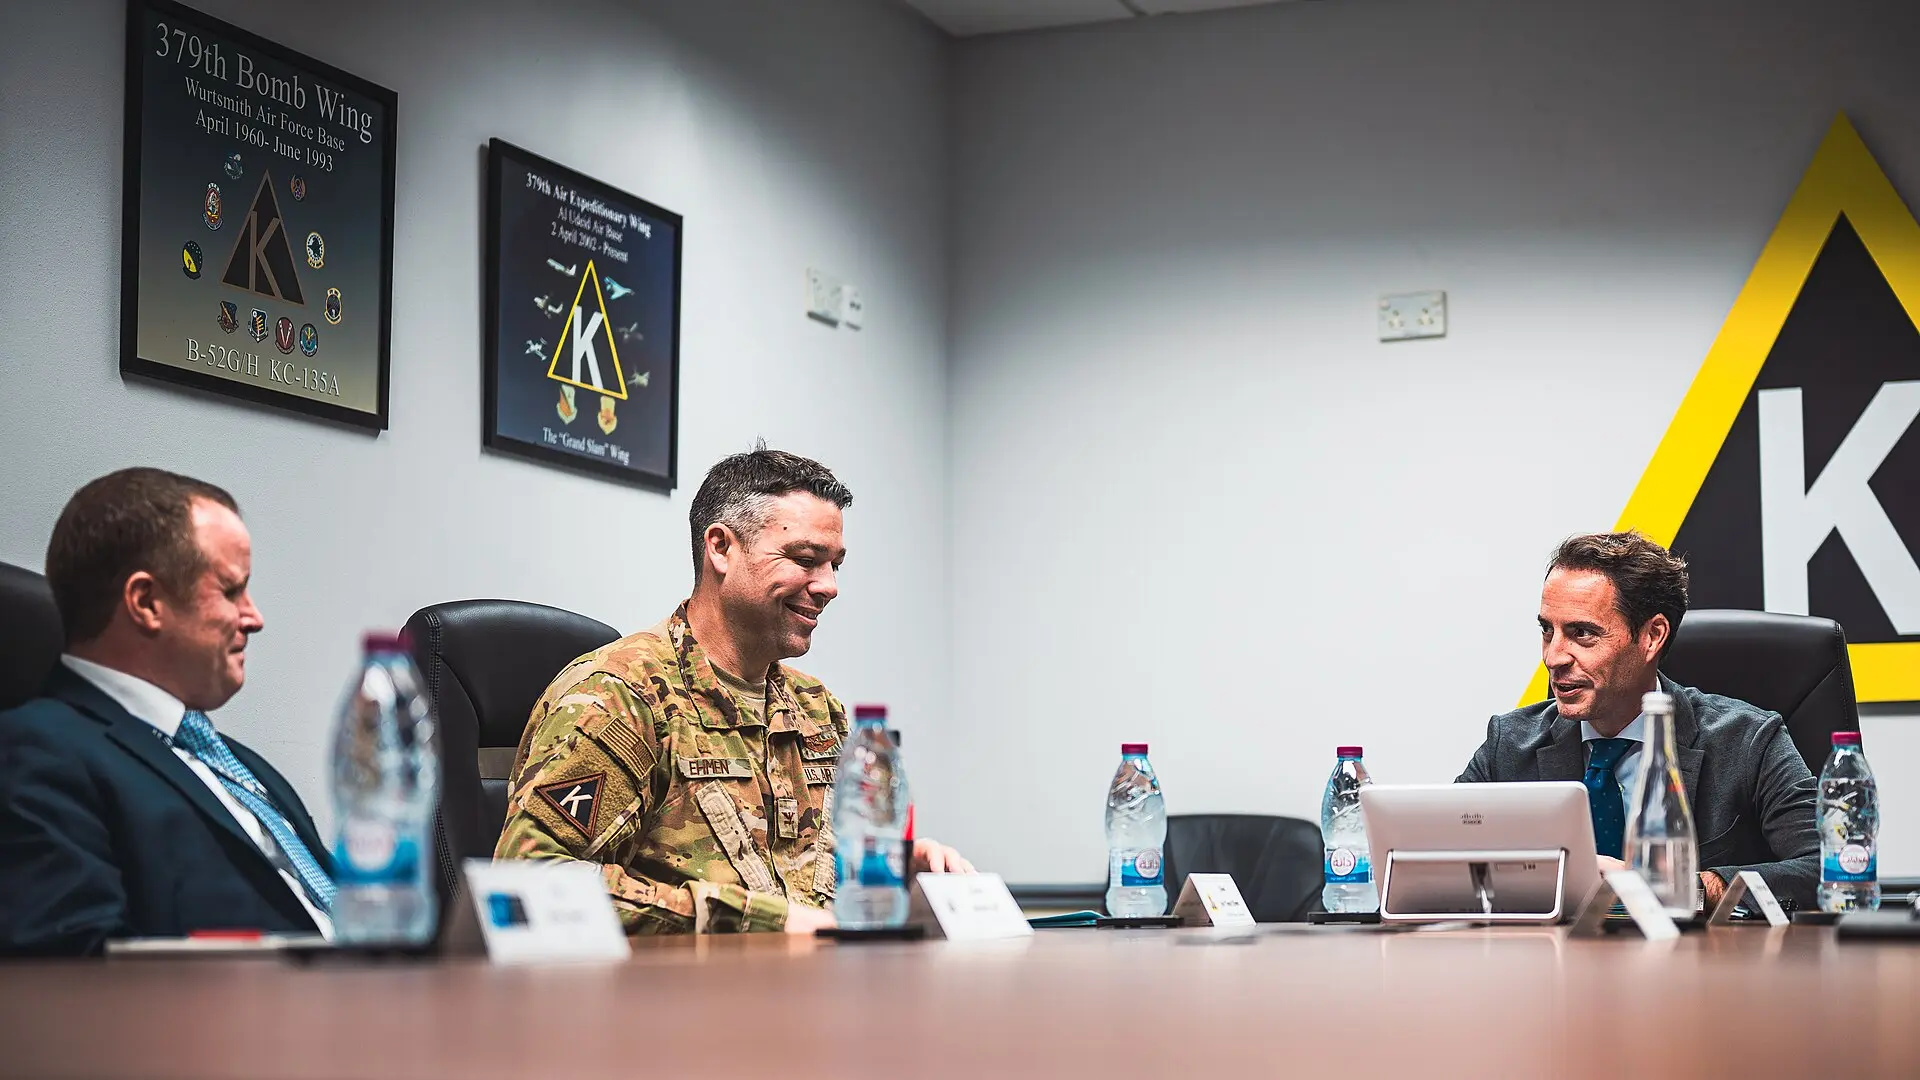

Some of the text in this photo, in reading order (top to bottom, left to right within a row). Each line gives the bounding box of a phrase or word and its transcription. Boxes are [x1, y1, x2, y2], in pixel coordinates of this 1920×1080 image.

[155, 22, 373, 143] 379th Bomb Wing
[185, 76, 345, 152] Wurtsmith Air Force Base
[196, 109, 333, 172] April 1960- June 1993
[526, 172, 651, 239] 379th Air Expeditionary Wing
[558, 206, 567, 221] Al
[592, 220, 603, 236] Air
[605, 224, 623, 243] Base
[250, 210, 284, 300] K
[551, 221, 557, 236] 2
[558, 225, 577, 244] April
[603, 241, 628, 263] Present
[186, 338, 341, 397] B-52G/H KC-135A
[572, 305, 603, 389] K
[543, 427, 557, 444] The
[610, 444, 629, 466] Wing
[1758, 379, 1920, 636] K
[689, 759, 730, 775] EHMEN
[560, 785, 593, 817] K
